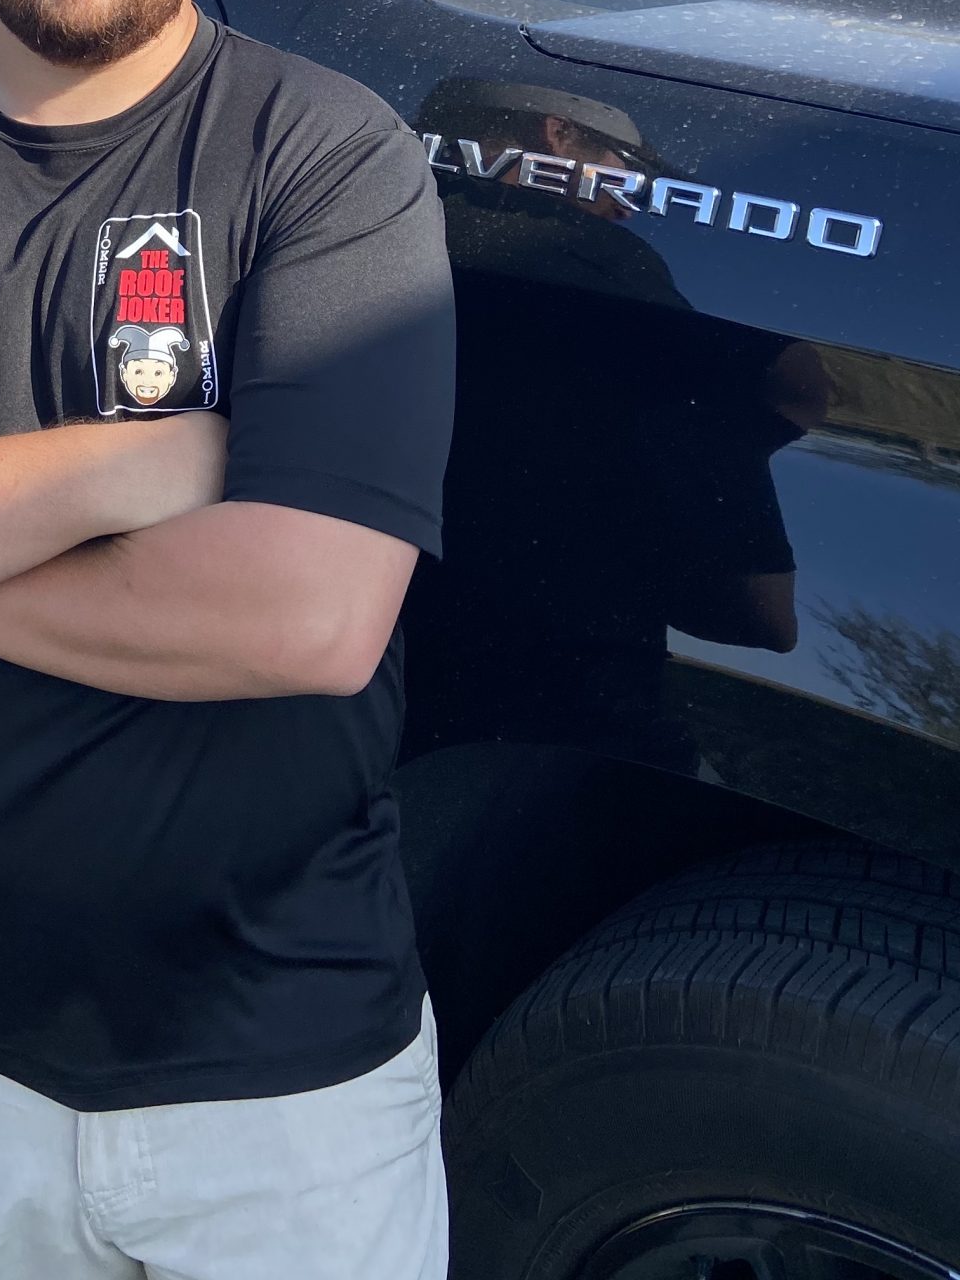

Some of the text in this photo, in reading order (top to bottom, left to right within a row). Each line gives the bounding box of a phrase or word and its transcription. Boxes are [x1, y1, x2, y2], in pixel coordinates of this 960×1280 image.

[413, 130, 883, 258] LVERADO
[97, 224, 111, 285] JOKER
[140, 249, 170, 269] THE
[119, 269, 185, 297] ROOF
[116, 297, 185, 324] JOKER
